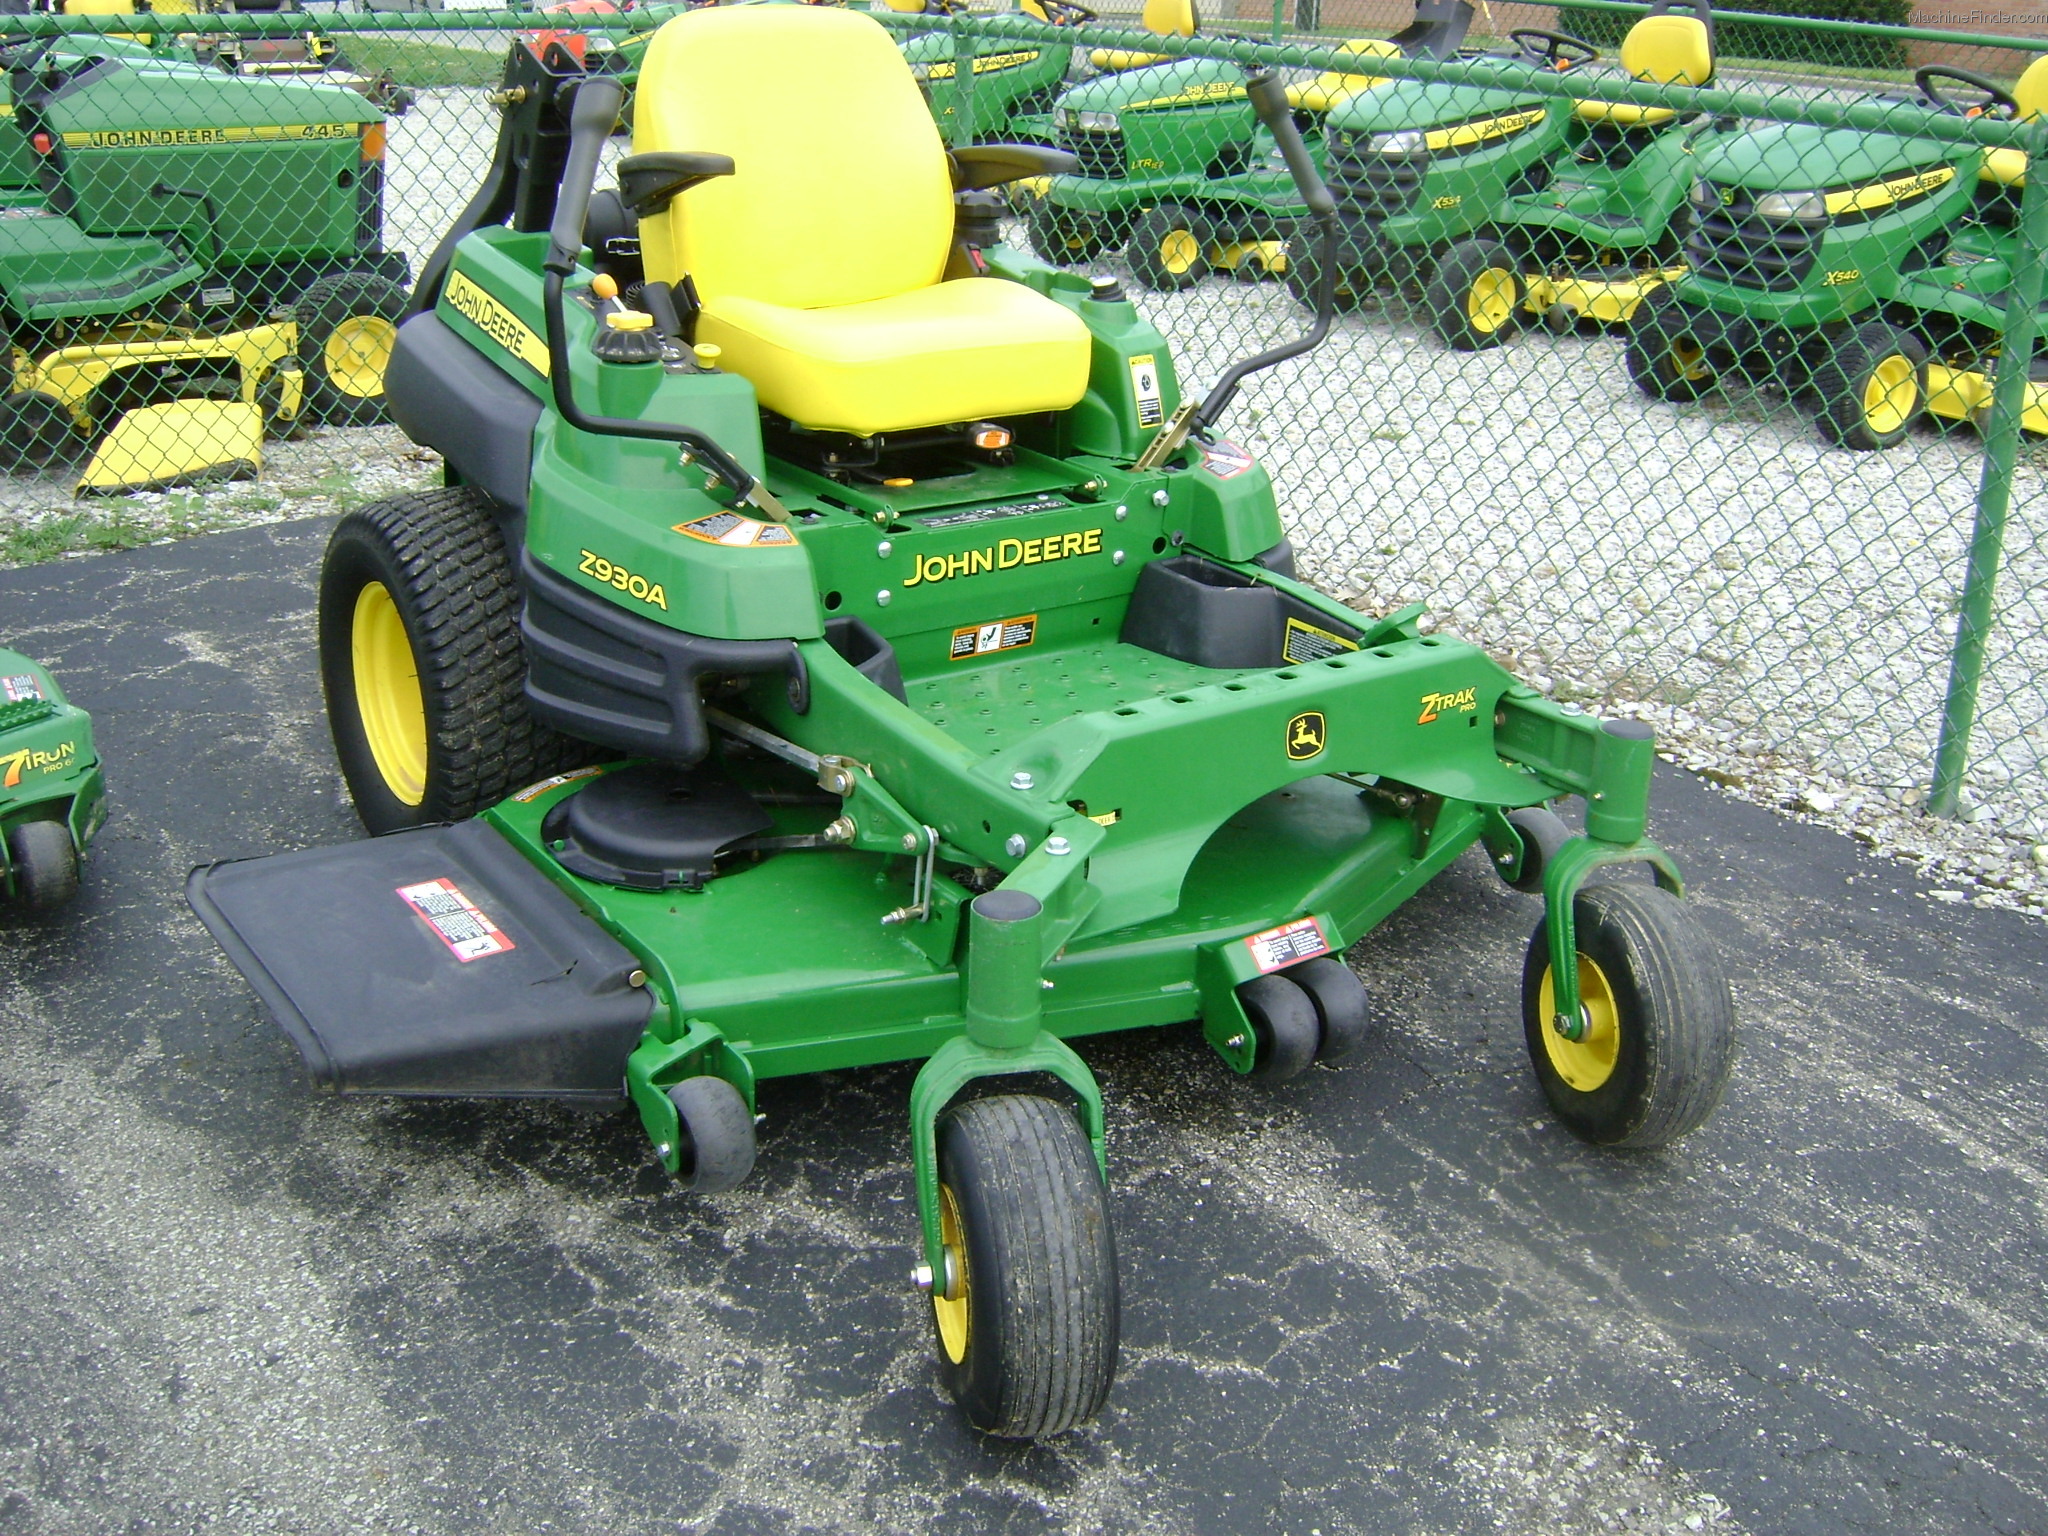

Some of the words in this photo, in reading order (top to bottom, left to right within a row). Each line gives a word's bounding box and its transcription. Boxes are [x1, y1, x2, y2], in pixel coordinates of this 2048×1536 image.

[92, 131, 154, 148] JOHN
[160, 128, 226, 145] DEERE
[301, 124, 346, 139] 445
[1887, 181, 1915, 198] JOHN
[1823, 269, 1859, 287] X540
[450, 278, 483, 319] JOHN
[481, 299, 527, 355] DEERE
[903, 547, 994, 587] JOHN
[997, 528, 1104, 570] DEERE
[577, 548, 669, 611] Z930A
[1458, 701, 1478, 714] PRO
[43, 761, 63, 775] PRO
